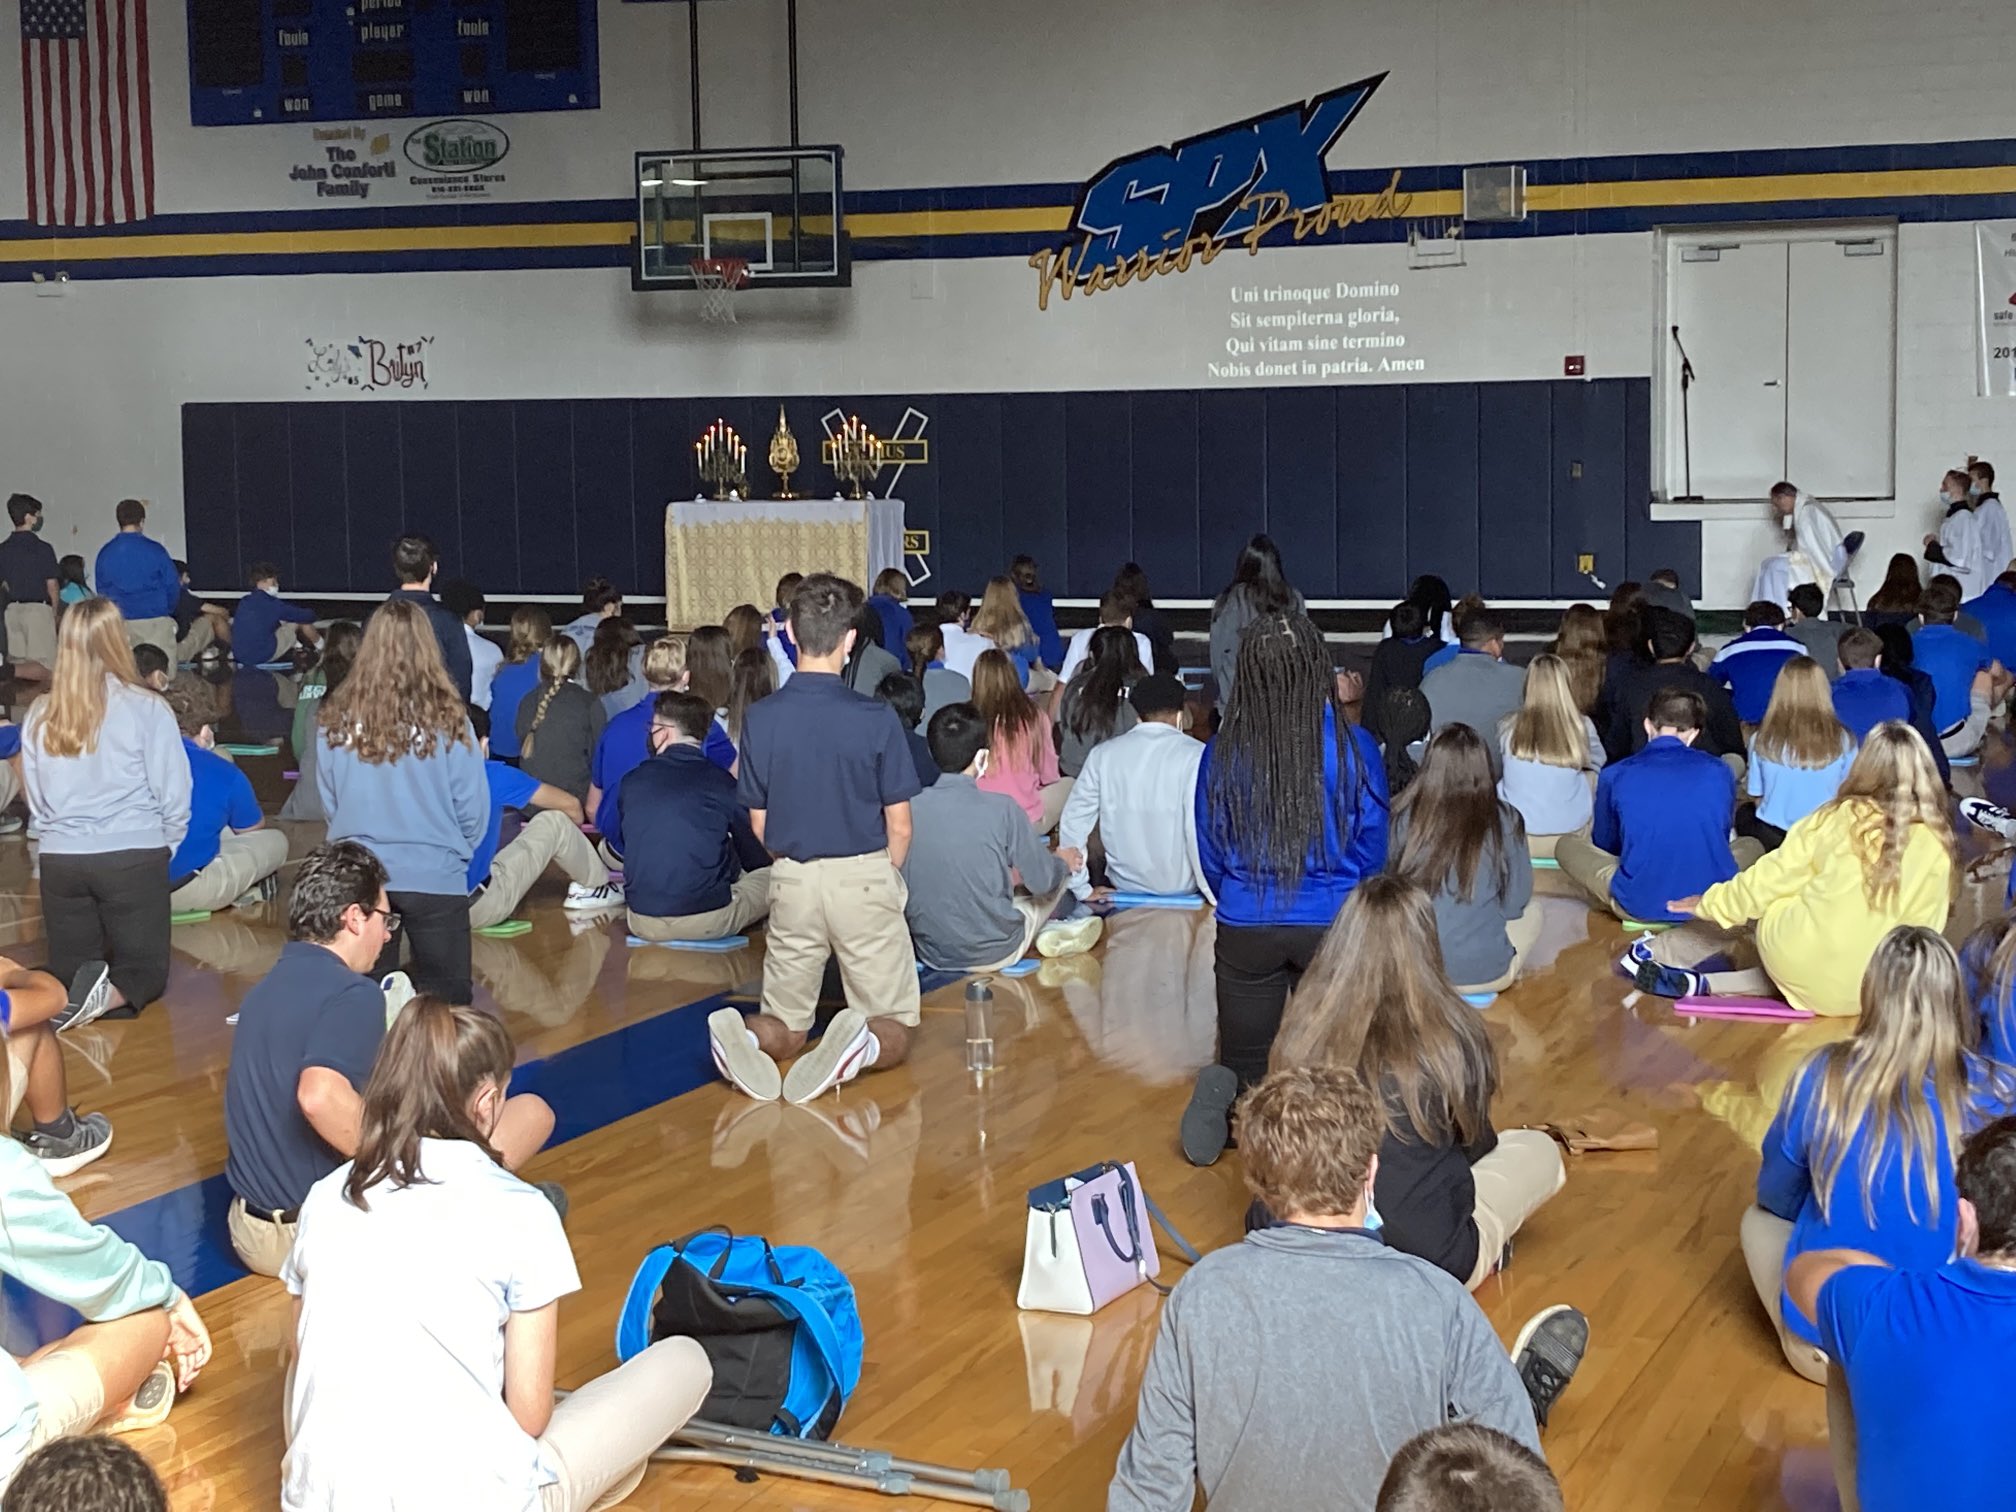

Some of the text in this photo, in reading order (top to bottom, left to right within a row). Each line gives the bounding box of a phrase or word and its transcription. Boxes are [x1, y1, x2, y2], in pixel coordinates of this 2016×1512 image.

[361, 22, 404, 43] player
[285, 98, 309, 111] won
[464, 90, 489, 103] won
[326, 147, 356, 162] The
[424, 132, 497, 165] Station
[289, 165, 327, 180] John
[317, 181, 369, 199] Family
[1029, 170, 1412, 310] Warrior Proud
[1231, 281, 1400, 304] Uni trinoque Domino
[1231, 306, 1400, 331] Sit sempiterna gloria,
[1226, 332, 1405, 356] Qui vitam sine termino
[1208, 357, 1425, 378] Nobis donet in patria. Amen
